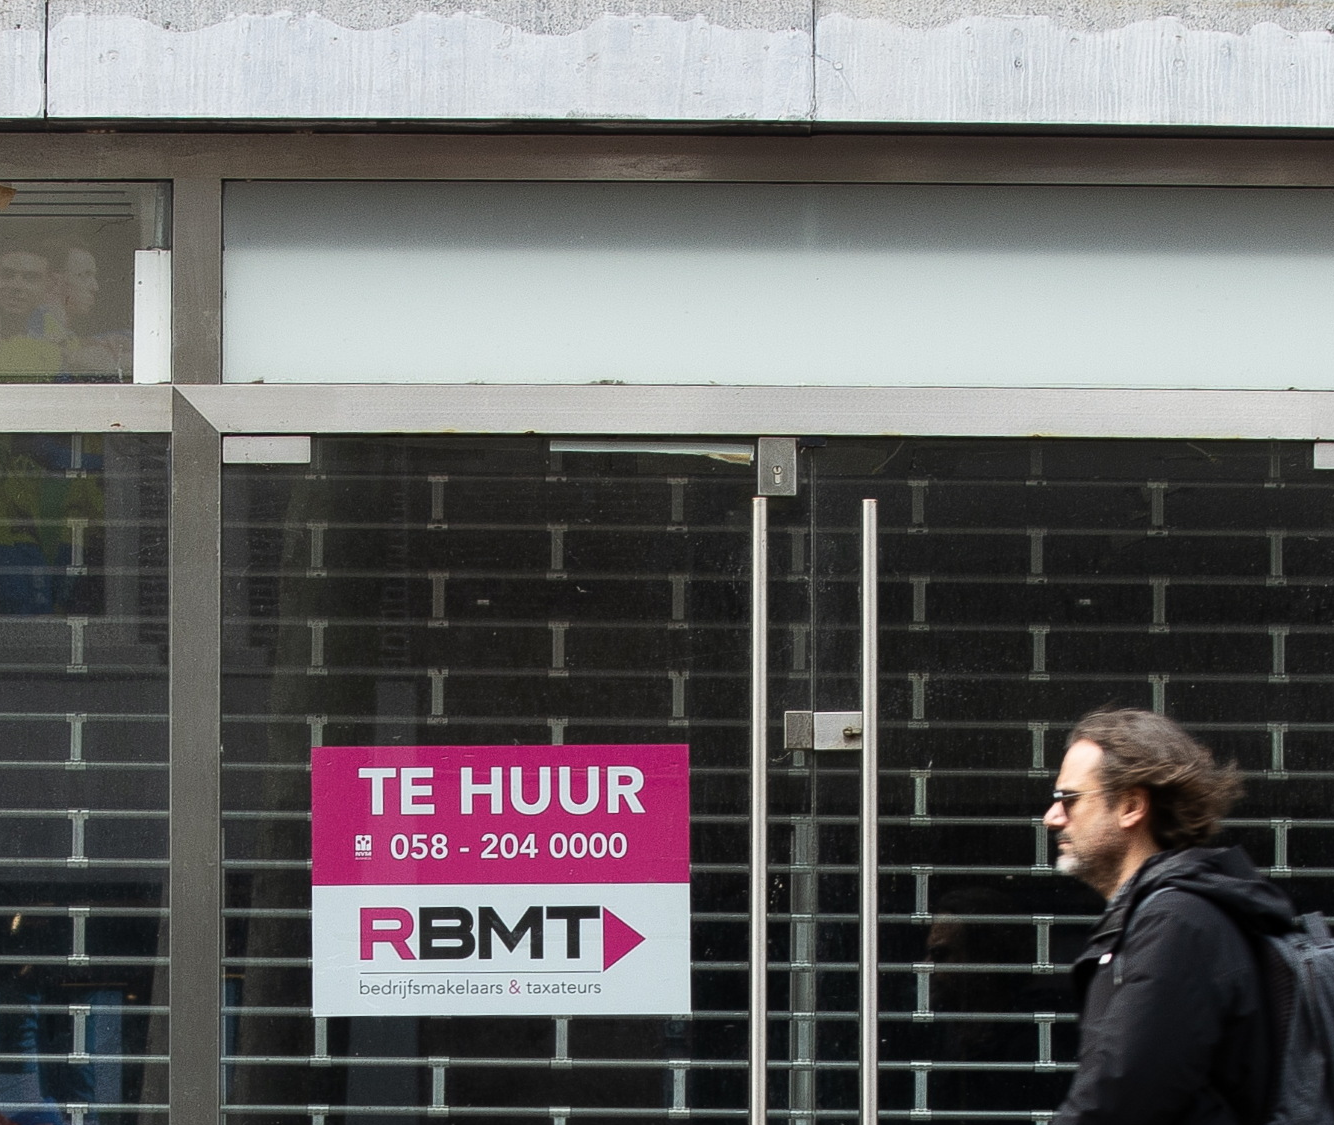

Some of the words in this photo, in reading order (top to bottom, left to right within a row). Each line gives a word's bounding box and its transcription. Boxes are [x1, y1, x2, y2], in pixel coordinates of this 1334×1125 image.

[358, 767, 435, 816] TE
[460, 765, 646, 815] HUUR
[390, 833, 449, 860] 058
[480, 832, 539, 860] 204
[549, 832, 628, 860] 0000
[359, 906, 601, 961] RBMT
[359, 979, 503, 1000] bedrijfsmakelaars
[509, 979, 522, 995] &
[526, 981, 602, 995] taxateurs
